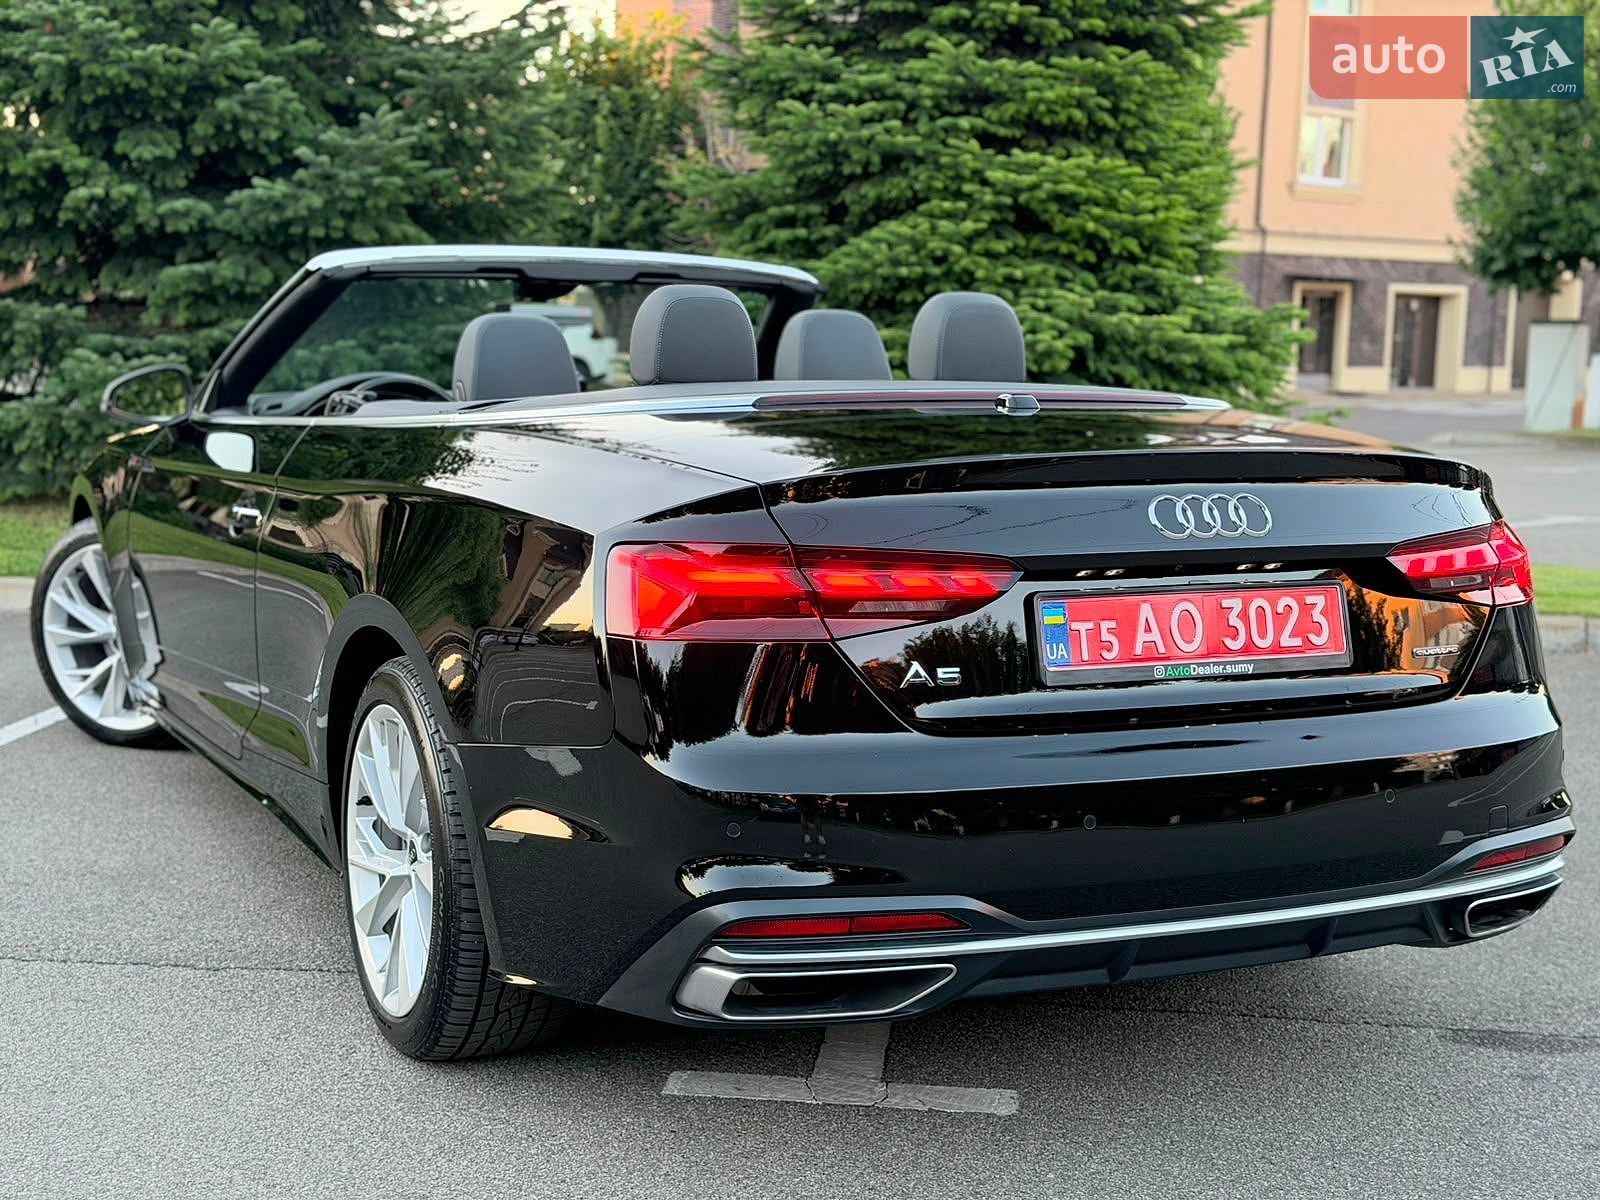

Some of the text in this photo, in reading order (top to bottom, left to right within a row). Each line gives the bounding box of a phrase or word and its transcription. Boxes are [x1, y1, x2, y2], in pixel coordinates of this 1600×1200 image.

[1071, 595, 1330, 662] T5 AO 3023
[1046, 643, 1068, 660] UA
[900, 661, 961, 688] A5
